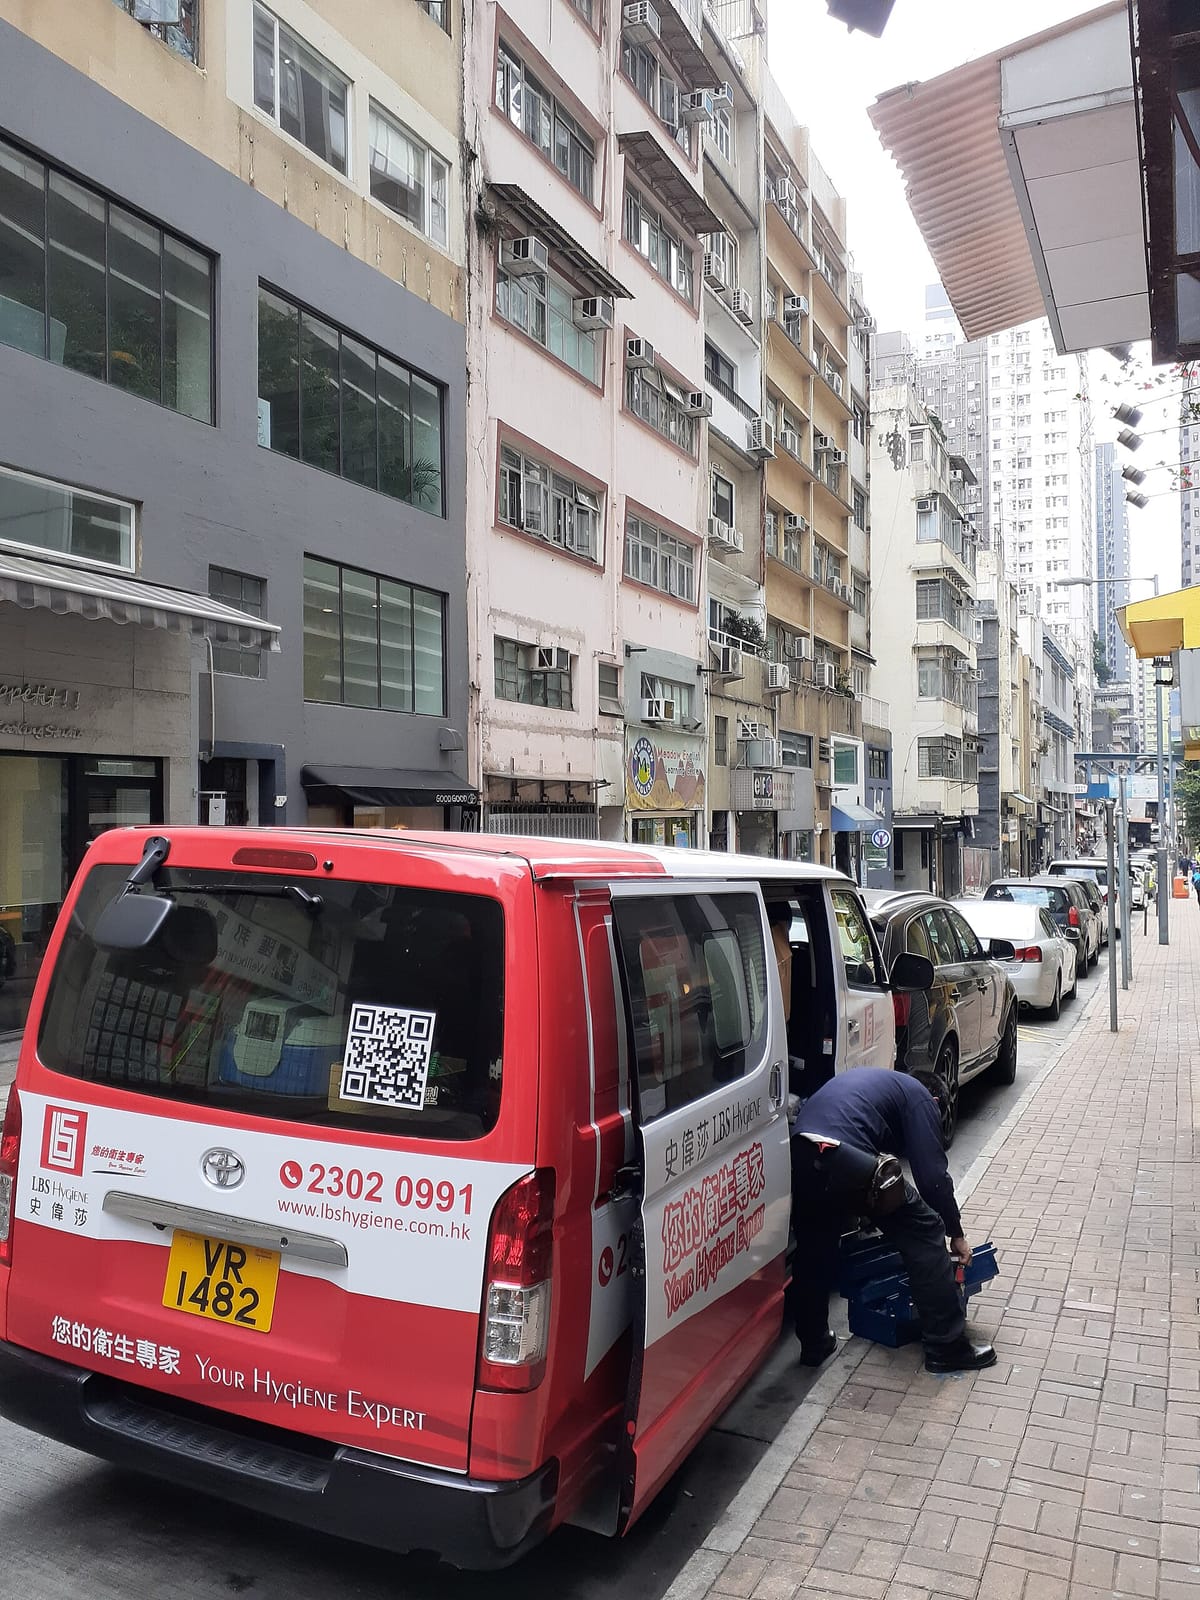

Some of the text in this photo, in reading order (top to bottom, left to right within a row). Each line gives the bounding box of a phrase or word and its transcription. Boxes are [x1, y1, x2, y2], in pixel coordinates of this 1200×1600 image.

[665, 1119, 709, 1182] 史偉莎
[712, 1107, 731, 1146] LBS
[32, 1176, 51, 1195] LBS
[307, 1163, 473, 1215] 2302 0991
[661, 1142, 766, 1274] 您的衛生專家
[30, 1197, 88, 1227] 史偉莎
[278, 1200, 471, 1241] www.lbshygiene.com.hk
[204, 1239, 247, 1284] VR
[176, 1270, 259, 1326] 1482
[51, 1315, 181, 1375] 您的衛生專家
